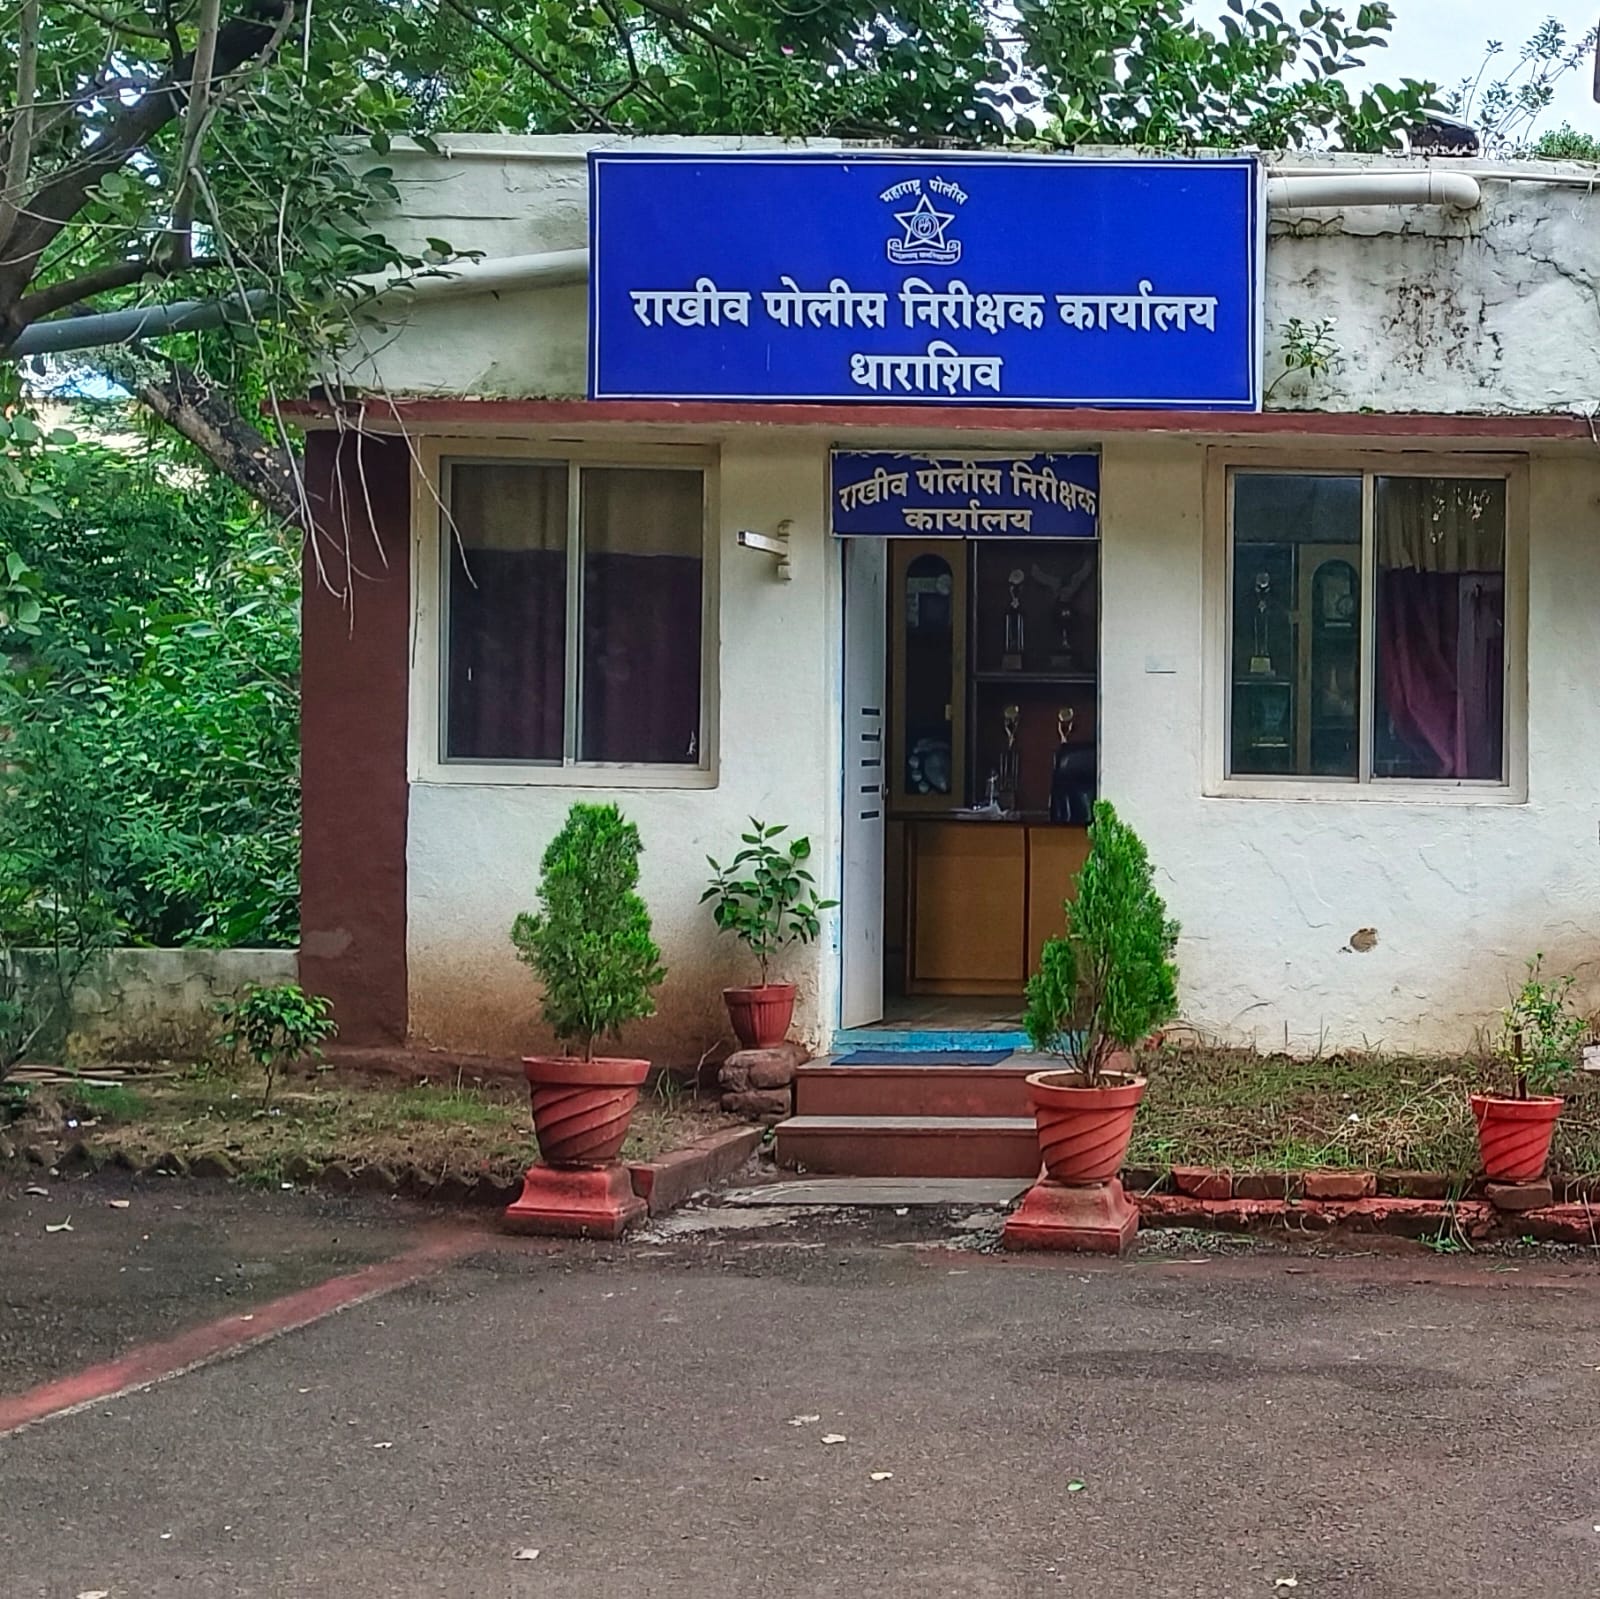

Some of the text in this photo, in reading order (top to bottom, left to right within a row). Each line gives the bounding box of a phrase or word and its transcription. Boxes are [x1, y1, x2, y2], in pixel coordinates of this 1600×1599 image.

[928, 176, 969, 206] पोलीस
[630, 277, 1218, 335] राखीव पोलीस निरीक्षक कार्यालय
[850, 340, 1003, 396] धाराशिव
[838, 460, 1097, 516] राखीव पोलीस निरीक्षक
[902, 499, 1034, 533] कार्यालय
